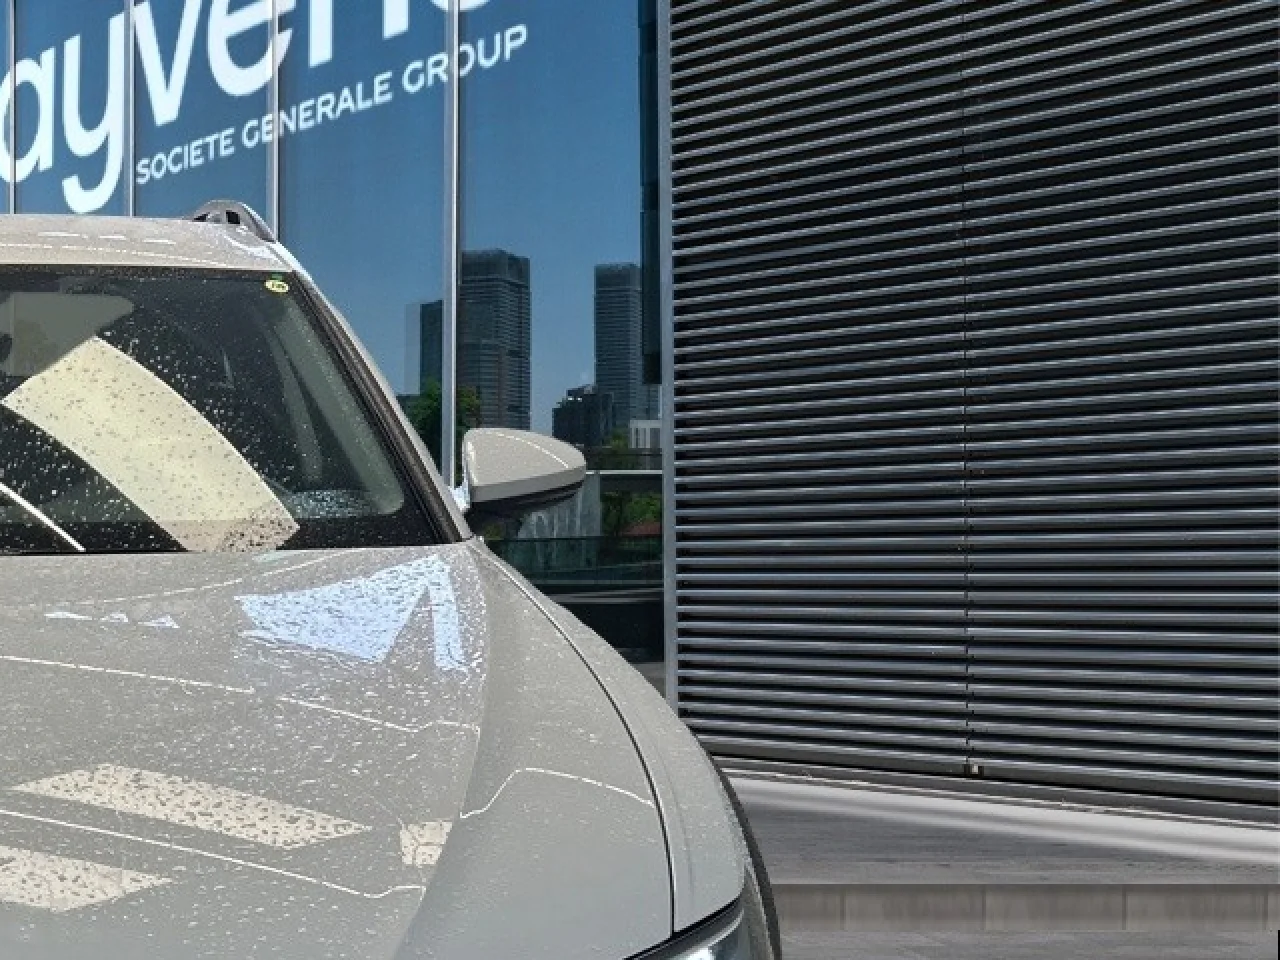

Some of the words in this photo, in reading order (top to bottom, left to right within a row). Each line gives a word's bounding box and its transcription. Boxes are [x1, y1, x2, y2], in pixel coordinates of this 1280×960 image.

[136, 126, 236, 185] SOCIETE
[241, 71, 393, 149] GENERALE
[401, 24, 527, 94] GROUP
